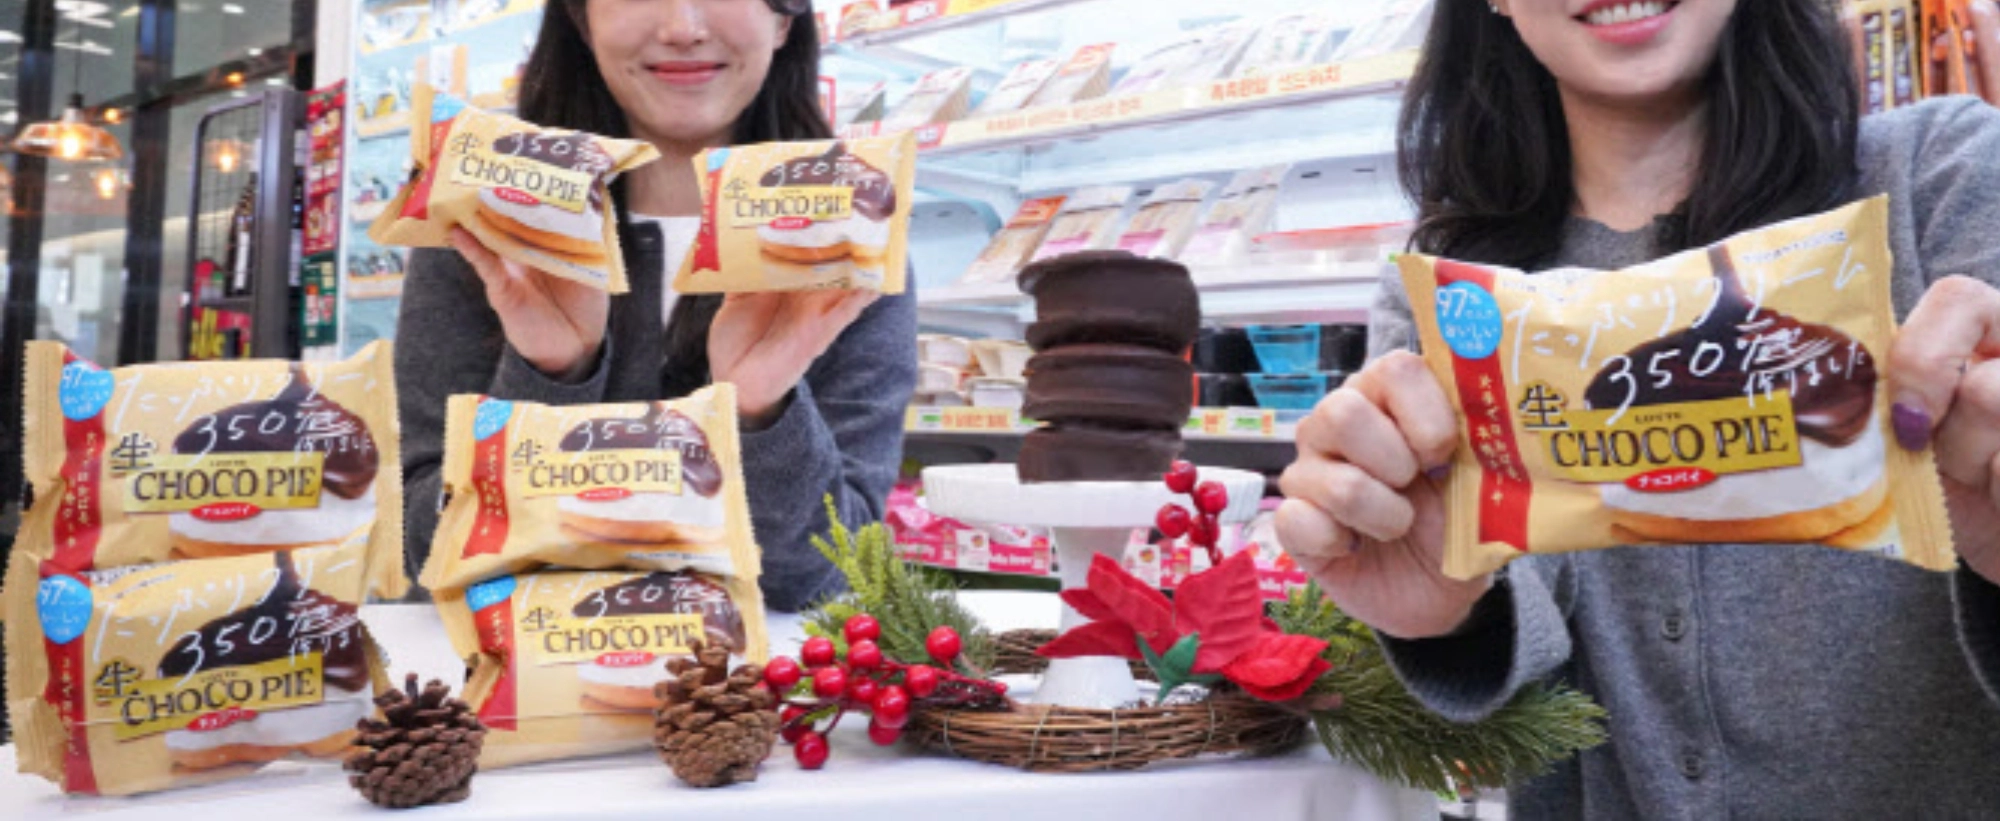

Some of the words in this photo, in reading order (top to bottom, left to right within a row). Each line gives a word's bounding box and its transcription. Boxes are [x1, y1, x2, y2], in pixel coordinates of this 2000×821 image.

[459, 155, 543, 191] CHOCO
[544, 174, 583, 203] PIE
[735, 195, 810, 218] CHOCO
[1518, 384, 1570, 430] 生
[1634, 410, 1683, 425] LOTTE
[111, 432, 154, 470] 生
[1551, 423, 1704, 467] CHOCO
[1712, 414, 1789, 459] PIE
[133, 469, 258, 501] CHOCO
[266, 467, 317, 498] PIE
[528, 462, 630, 489] CHOCO
[634, 459, 675, 483] PIE
[1637, 472, 1702, 488] チョコパイ
[543, 624, 649, 654] CHOCO
[96, 661, 141, 699] 生
[120, 679, 253, 726] CHOCO
[261, 667, 315, 702] PIE
